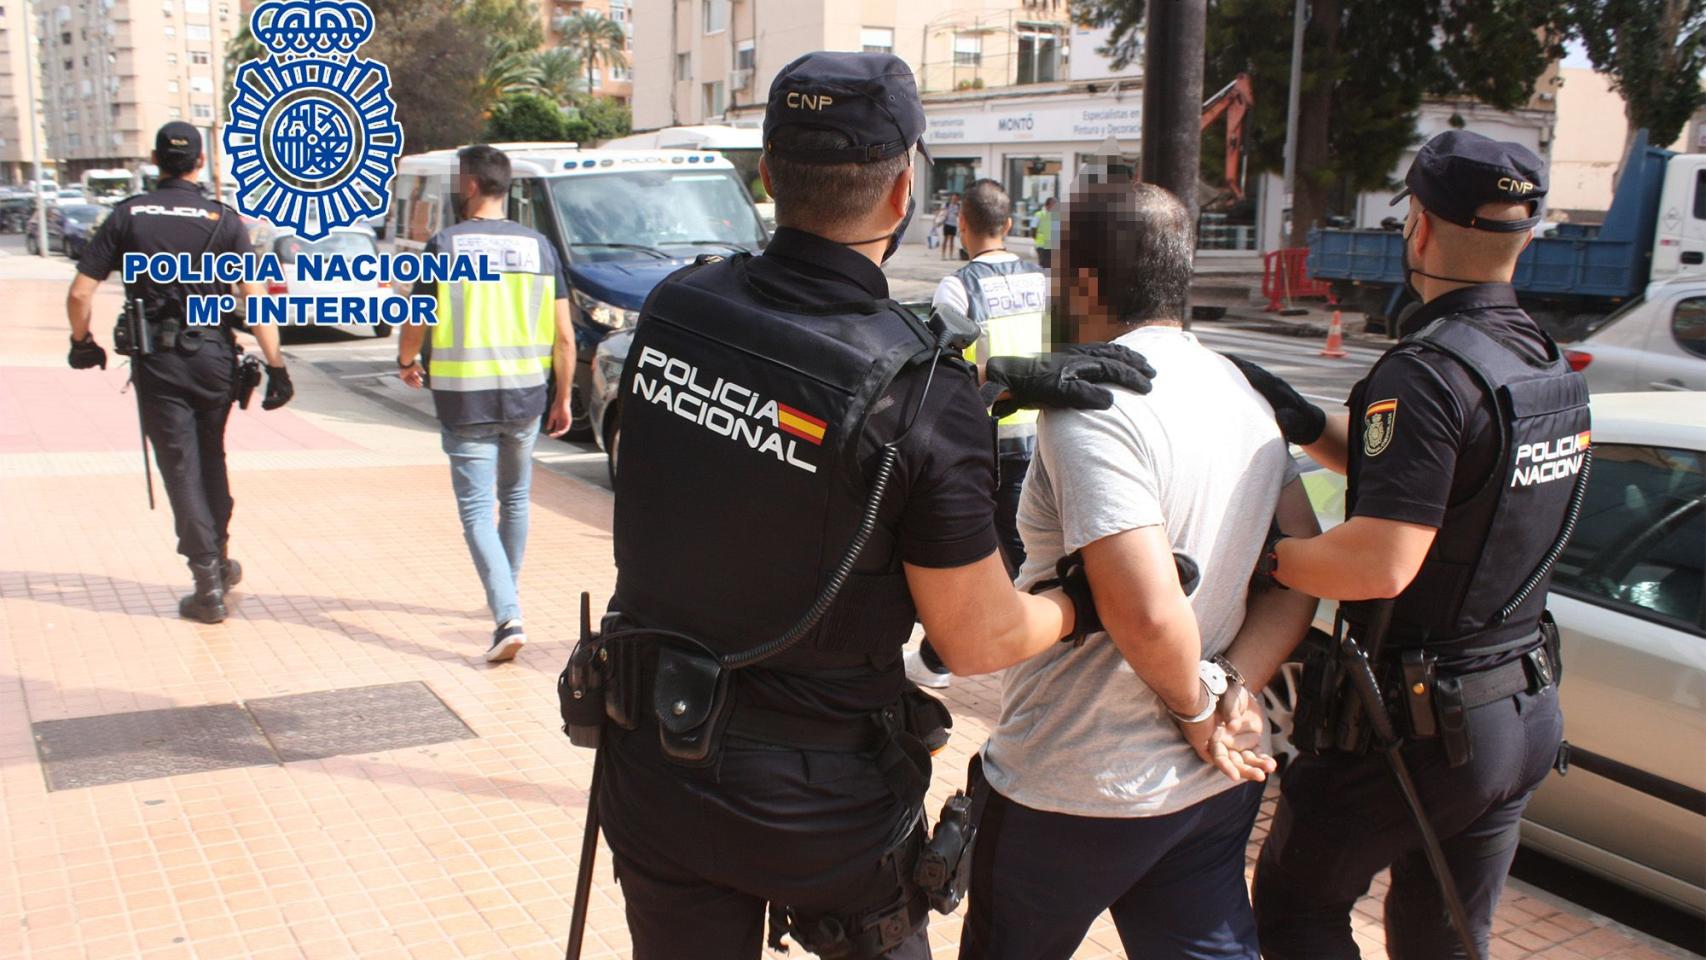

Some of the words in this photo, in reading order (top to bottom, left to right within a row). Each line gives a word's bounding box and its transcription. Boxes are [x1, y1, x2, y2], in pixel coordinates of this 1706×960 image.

[786, 91, 833, 111] CNP
[1497, 177, 1534, 194] CNP
[130, 205, 209, 218] POLICIA
[632, 372, 817, 474] NACIONAL
[1515, 434, 1581, 465] POLICIA
